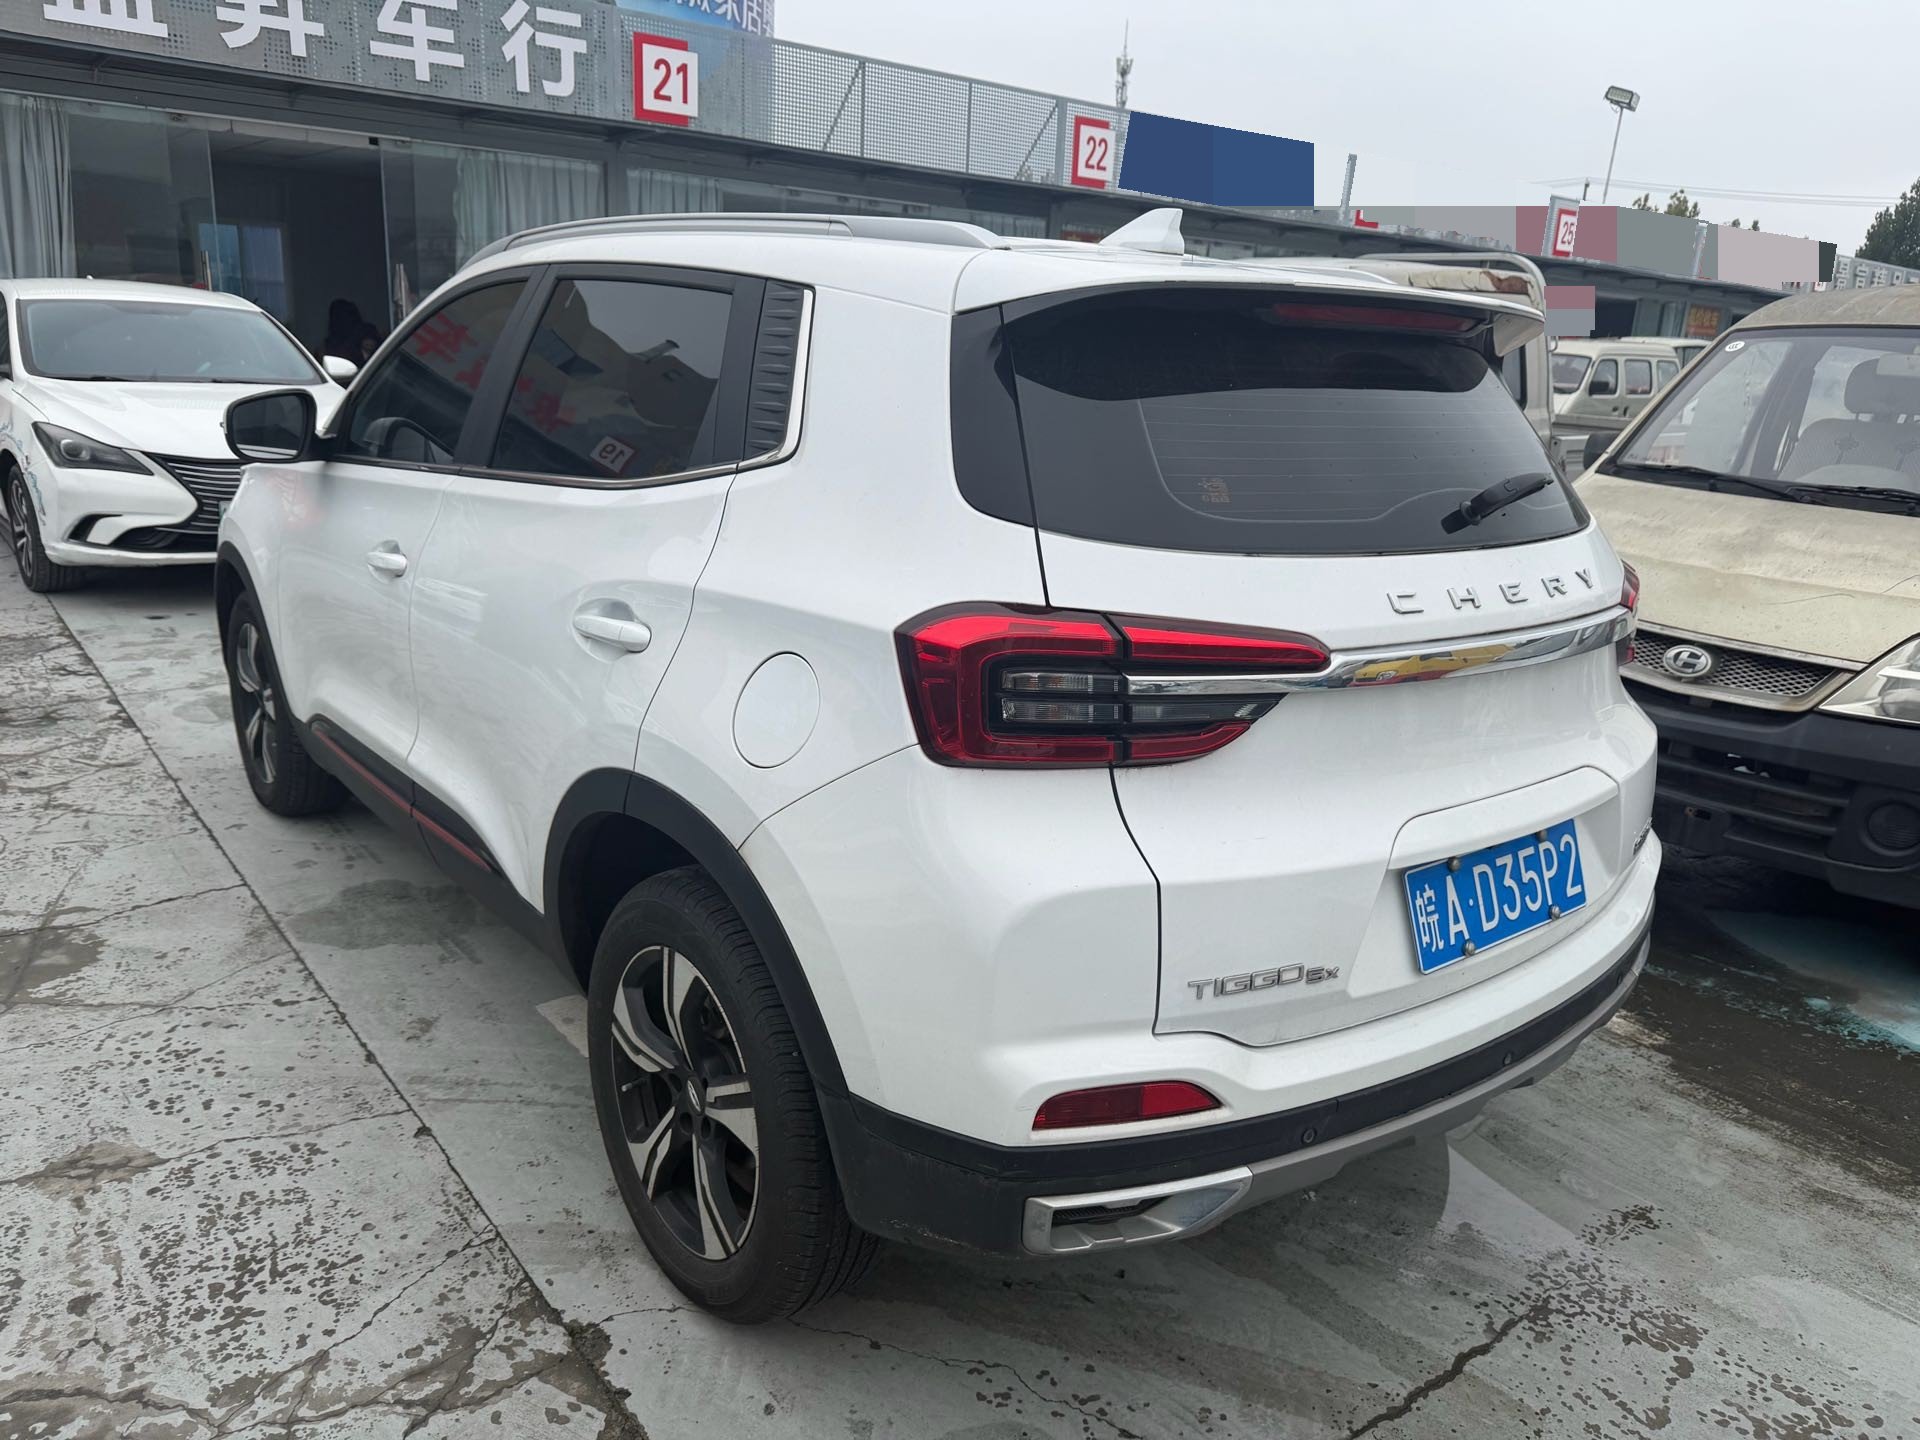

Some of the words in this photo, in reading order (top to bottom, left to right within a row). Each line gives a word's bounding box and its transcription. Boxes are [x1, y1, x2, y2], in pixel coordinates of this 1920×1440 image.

[653, 58, 689, 105] 21
[1085, 135, 1108, 172] 22
[1561, 221, 1575, 245] 25
[1386, 568, 1594, 614] CHERY
